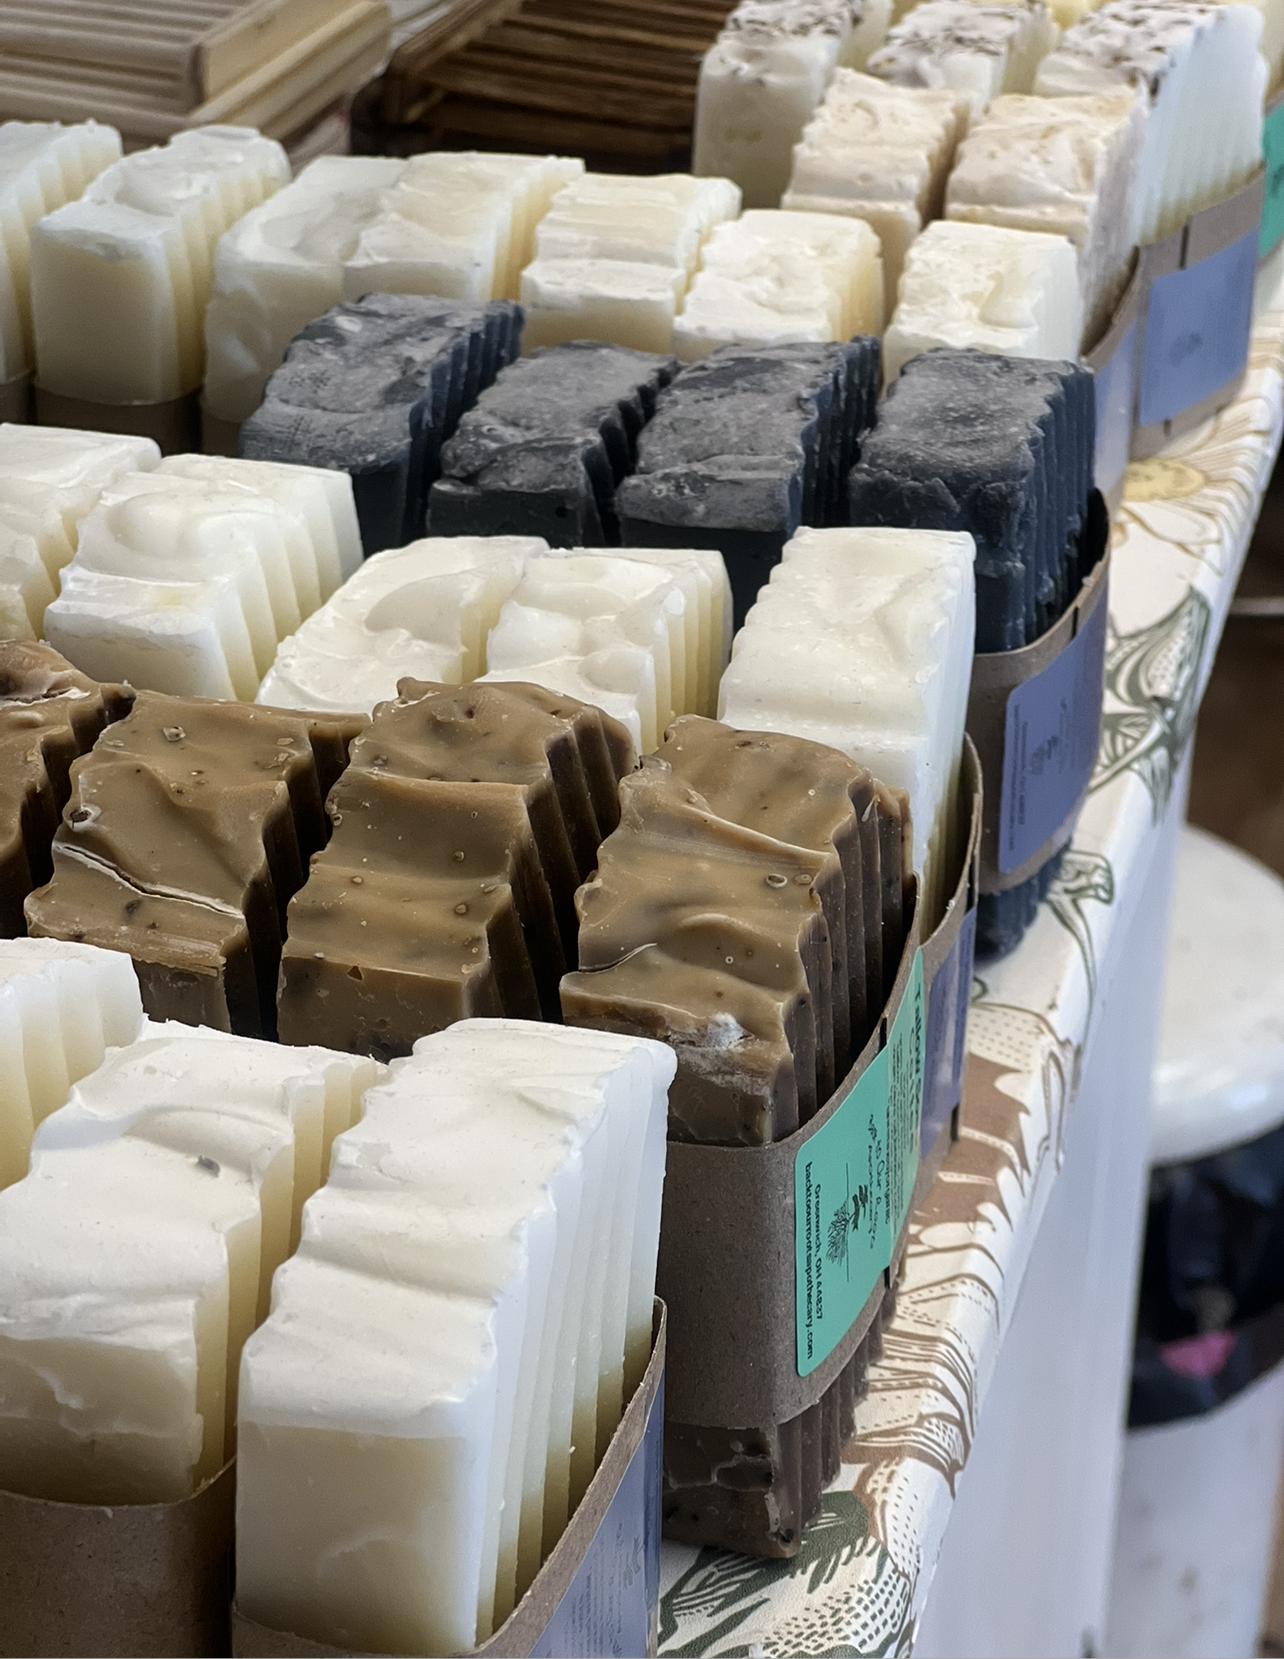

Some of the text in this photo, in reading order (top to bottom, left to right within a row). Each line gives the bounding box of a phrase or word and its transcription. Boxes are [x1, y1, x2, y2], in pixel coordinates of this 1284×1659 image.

[876, 1160, 885, 1190] Our
[804, 1161, 813, 1360] backtoourrootsapothecary.com
[813, 1183, 822, 1320] Greenwich, OH 44837
